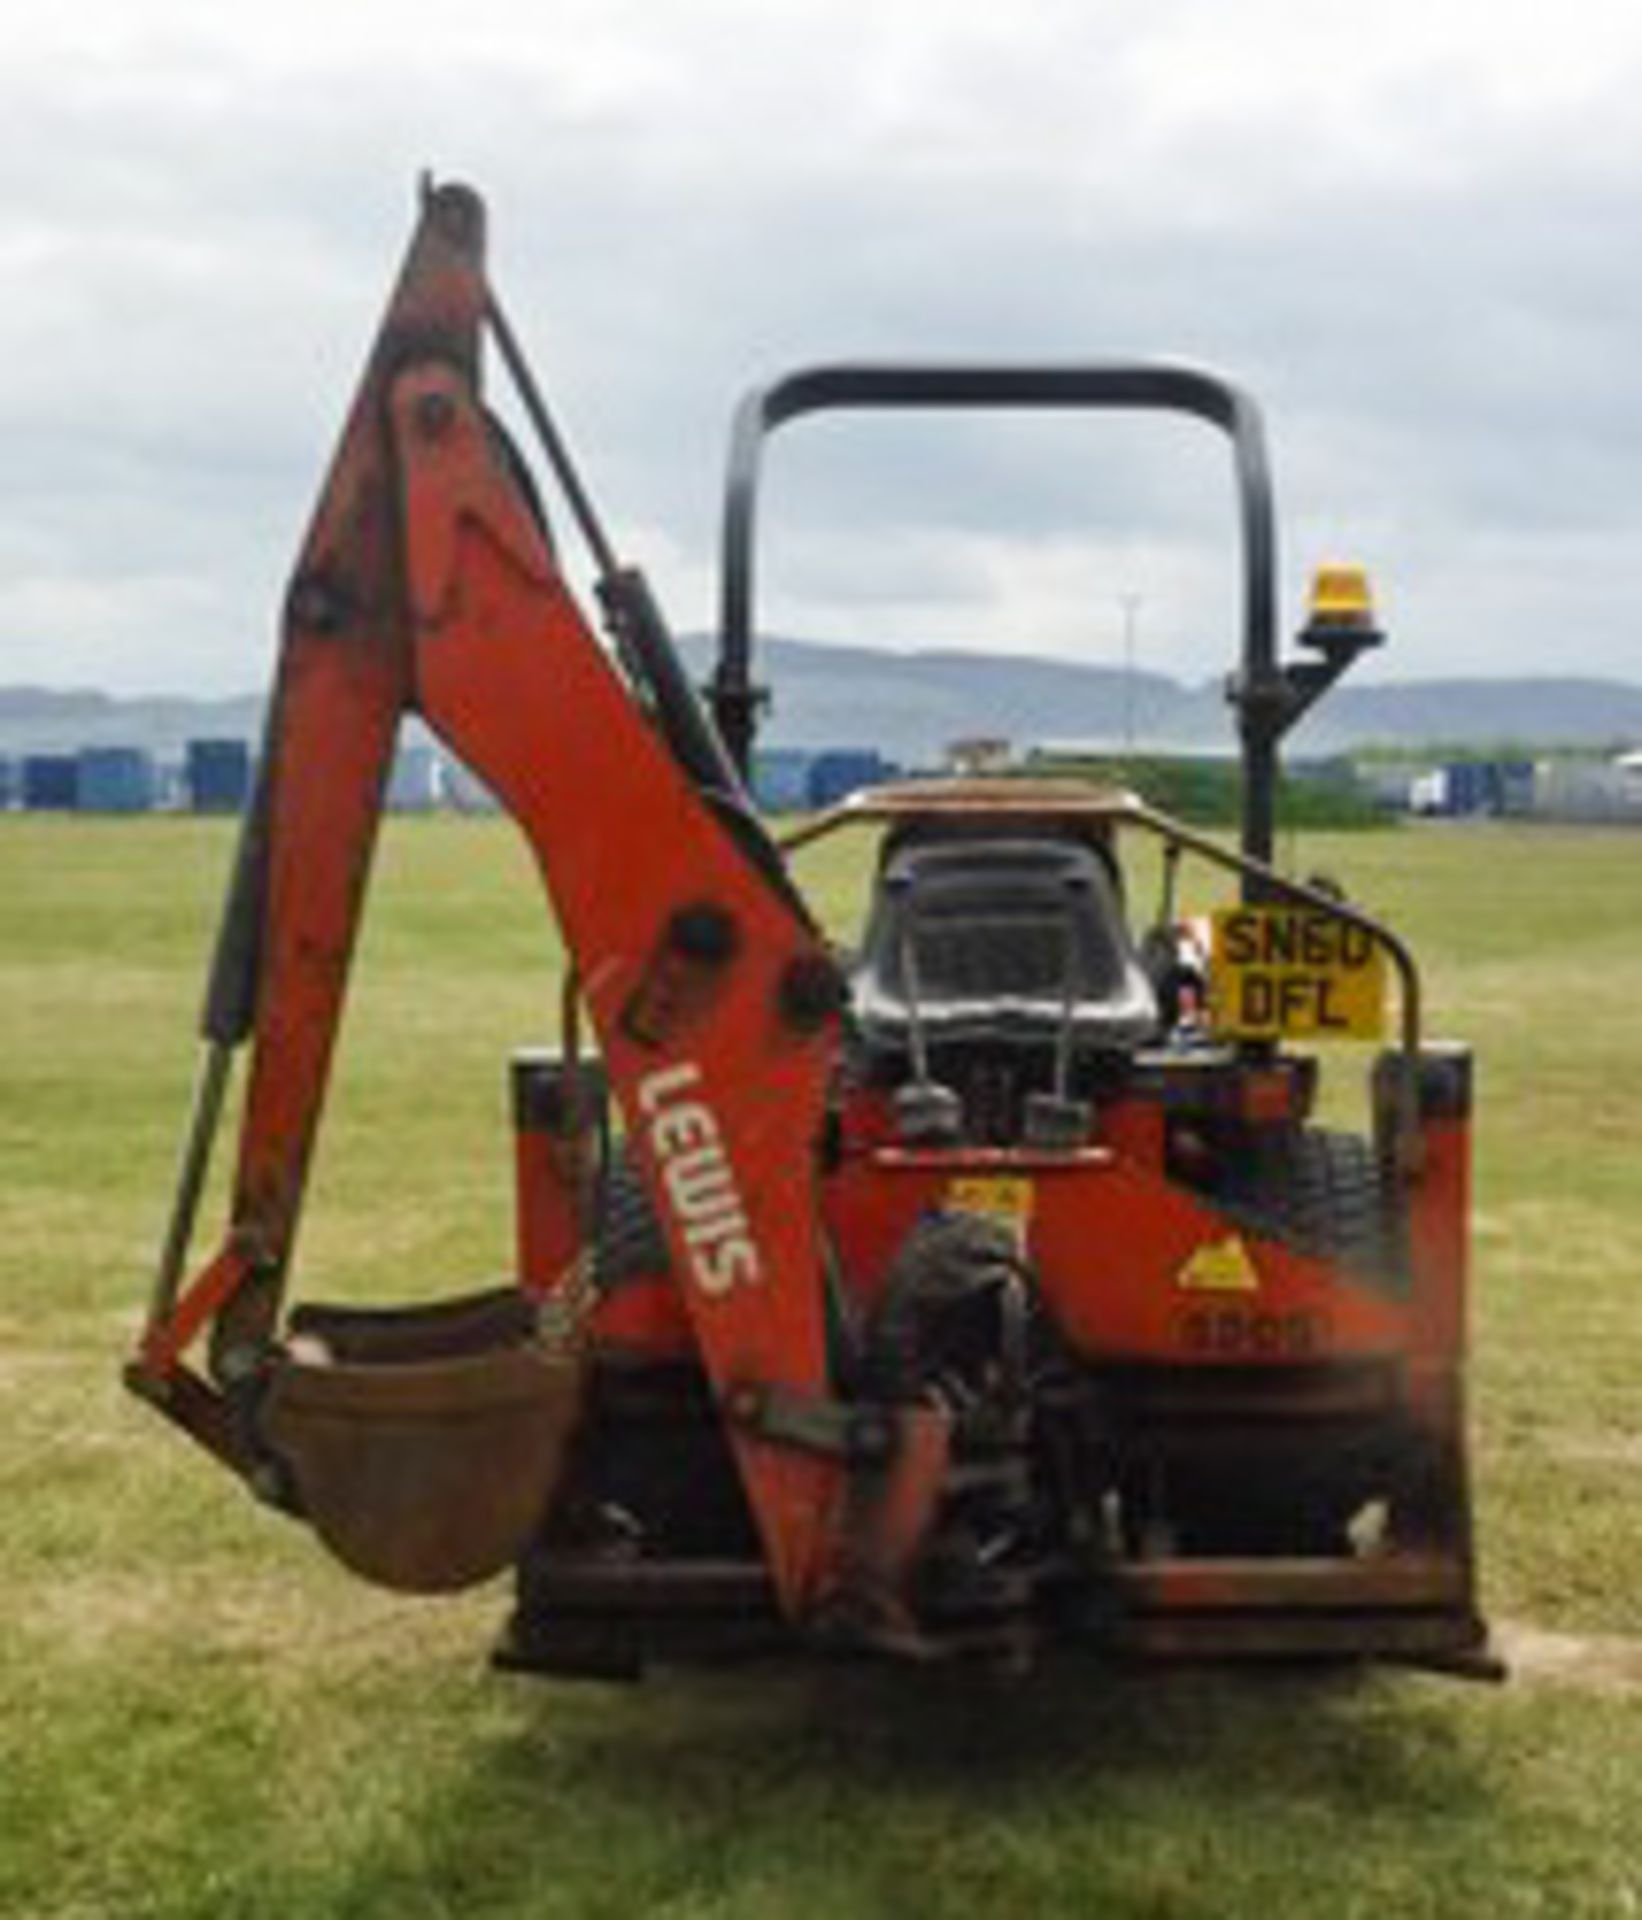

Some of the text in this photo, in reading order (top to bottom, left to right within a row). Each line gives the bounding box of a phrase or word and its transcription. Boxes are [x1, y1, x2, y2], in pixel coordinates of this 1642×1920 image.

[1225, 913, 1373, 968] SN60
[1240, 973, 1350, 1027] DFL
[638, 1063, 762, 1293] LEWIS
